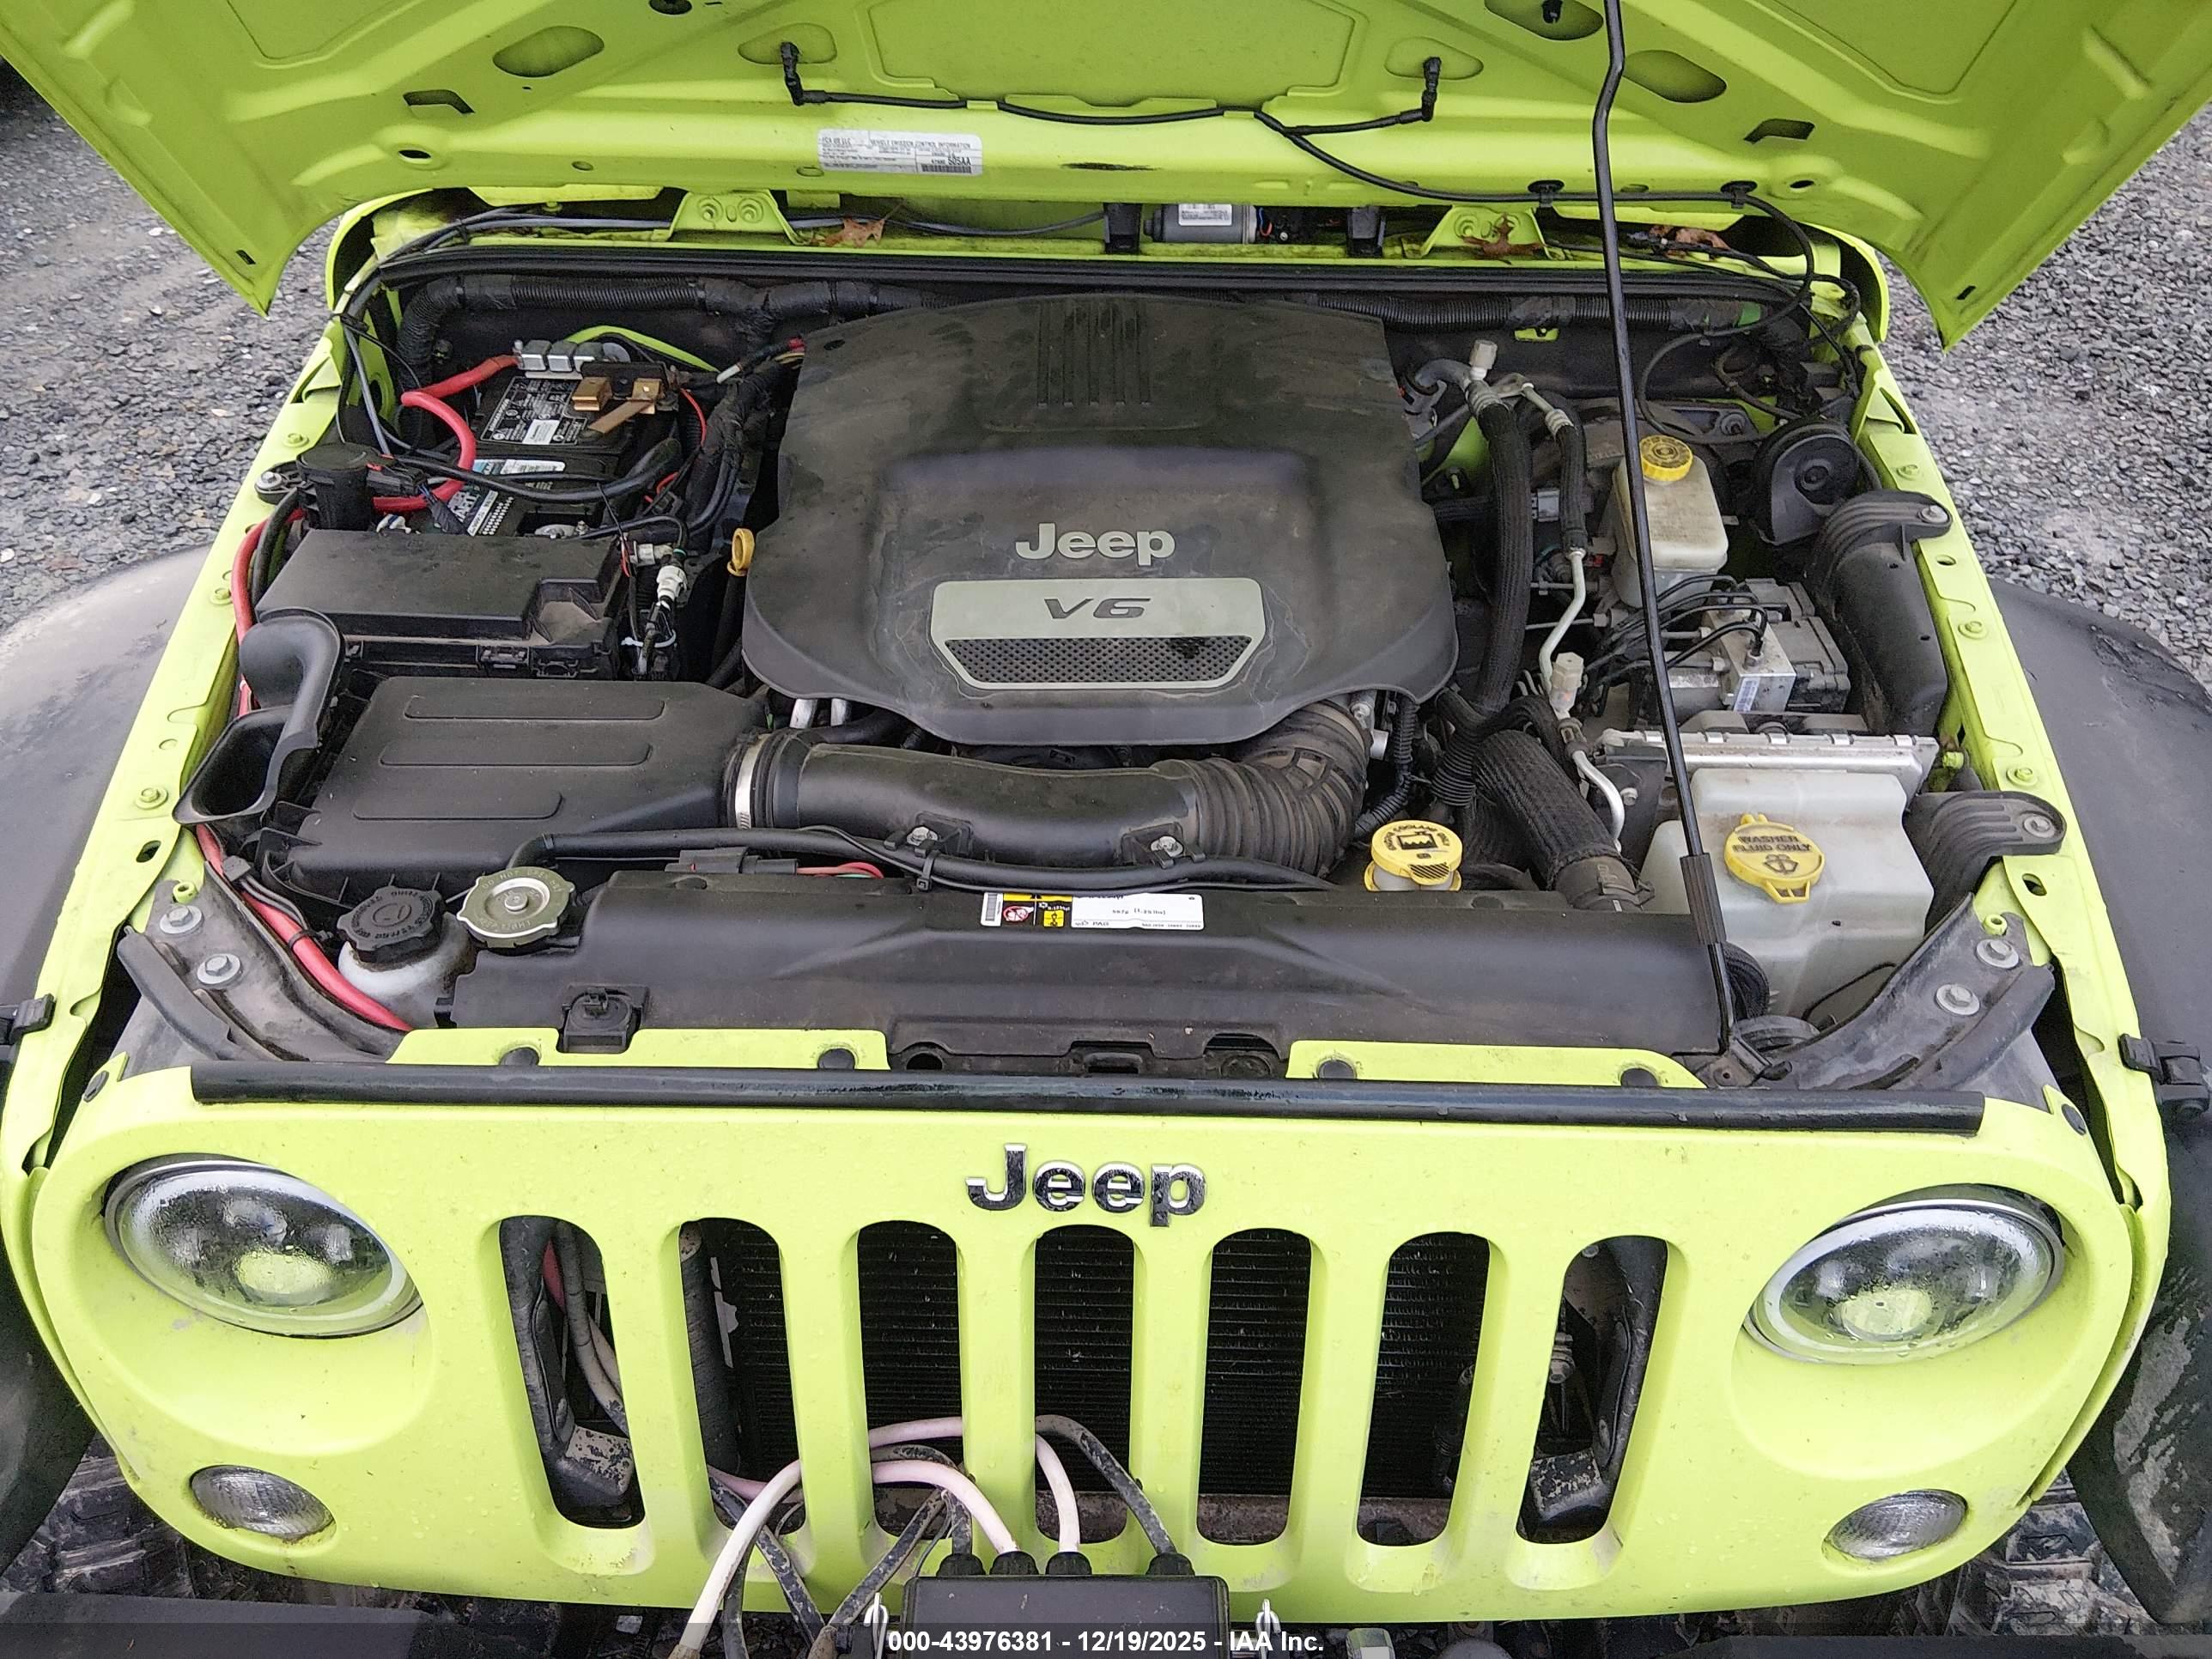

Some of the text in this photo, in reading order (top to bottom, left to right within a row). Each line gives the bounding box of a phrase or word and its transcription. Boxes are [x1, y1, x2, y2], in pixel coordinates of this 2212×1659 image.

[1015, 522, 1176, 566] Jeep
[1044, 598, 1151, 619] V6
[1732, 843, 1811, 852] FLUID ONLY
[1737, 836, 1799, 844] WASHER
[965, 1142, 1206, 1227] Jeep
